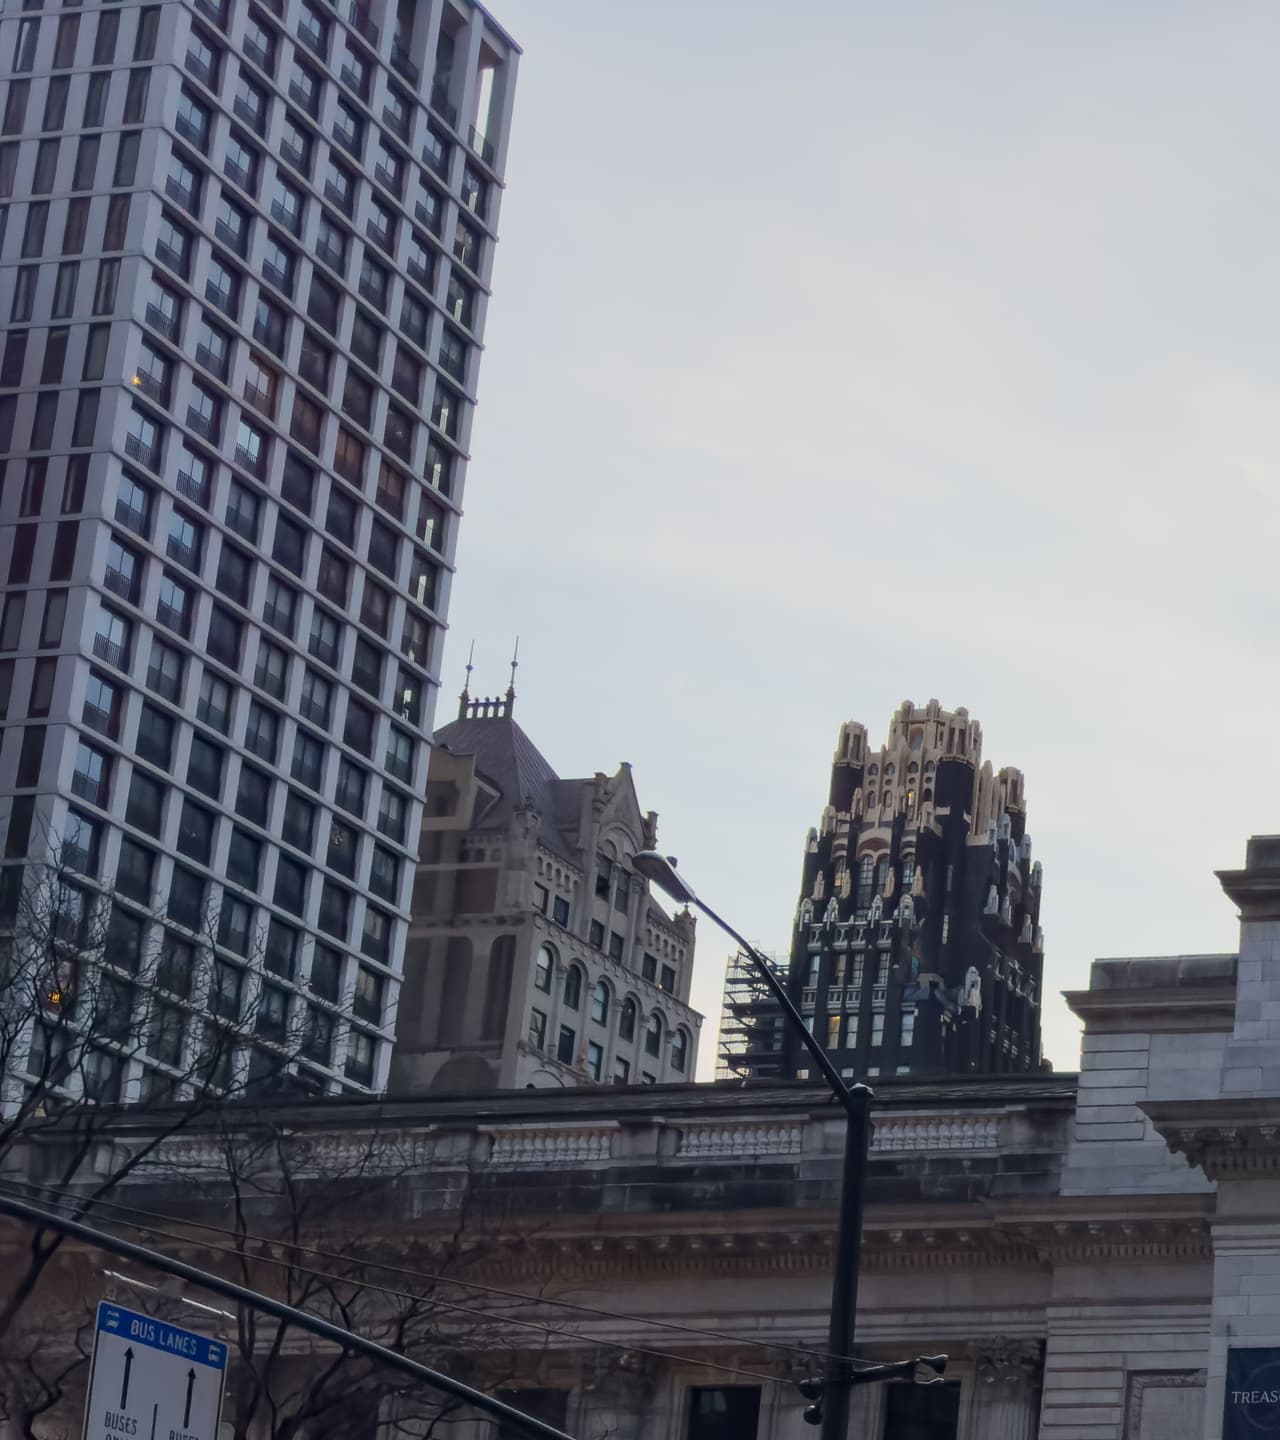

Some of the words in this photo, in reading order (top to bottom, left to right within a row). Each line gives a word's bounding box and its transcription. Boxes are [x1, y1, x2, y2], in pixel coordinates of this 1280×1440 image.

[130, 1319, 154, 1342] BUS
[159, 1329, 197, 1355] LANES
[104, 1410, 137, 1435] BUSES
